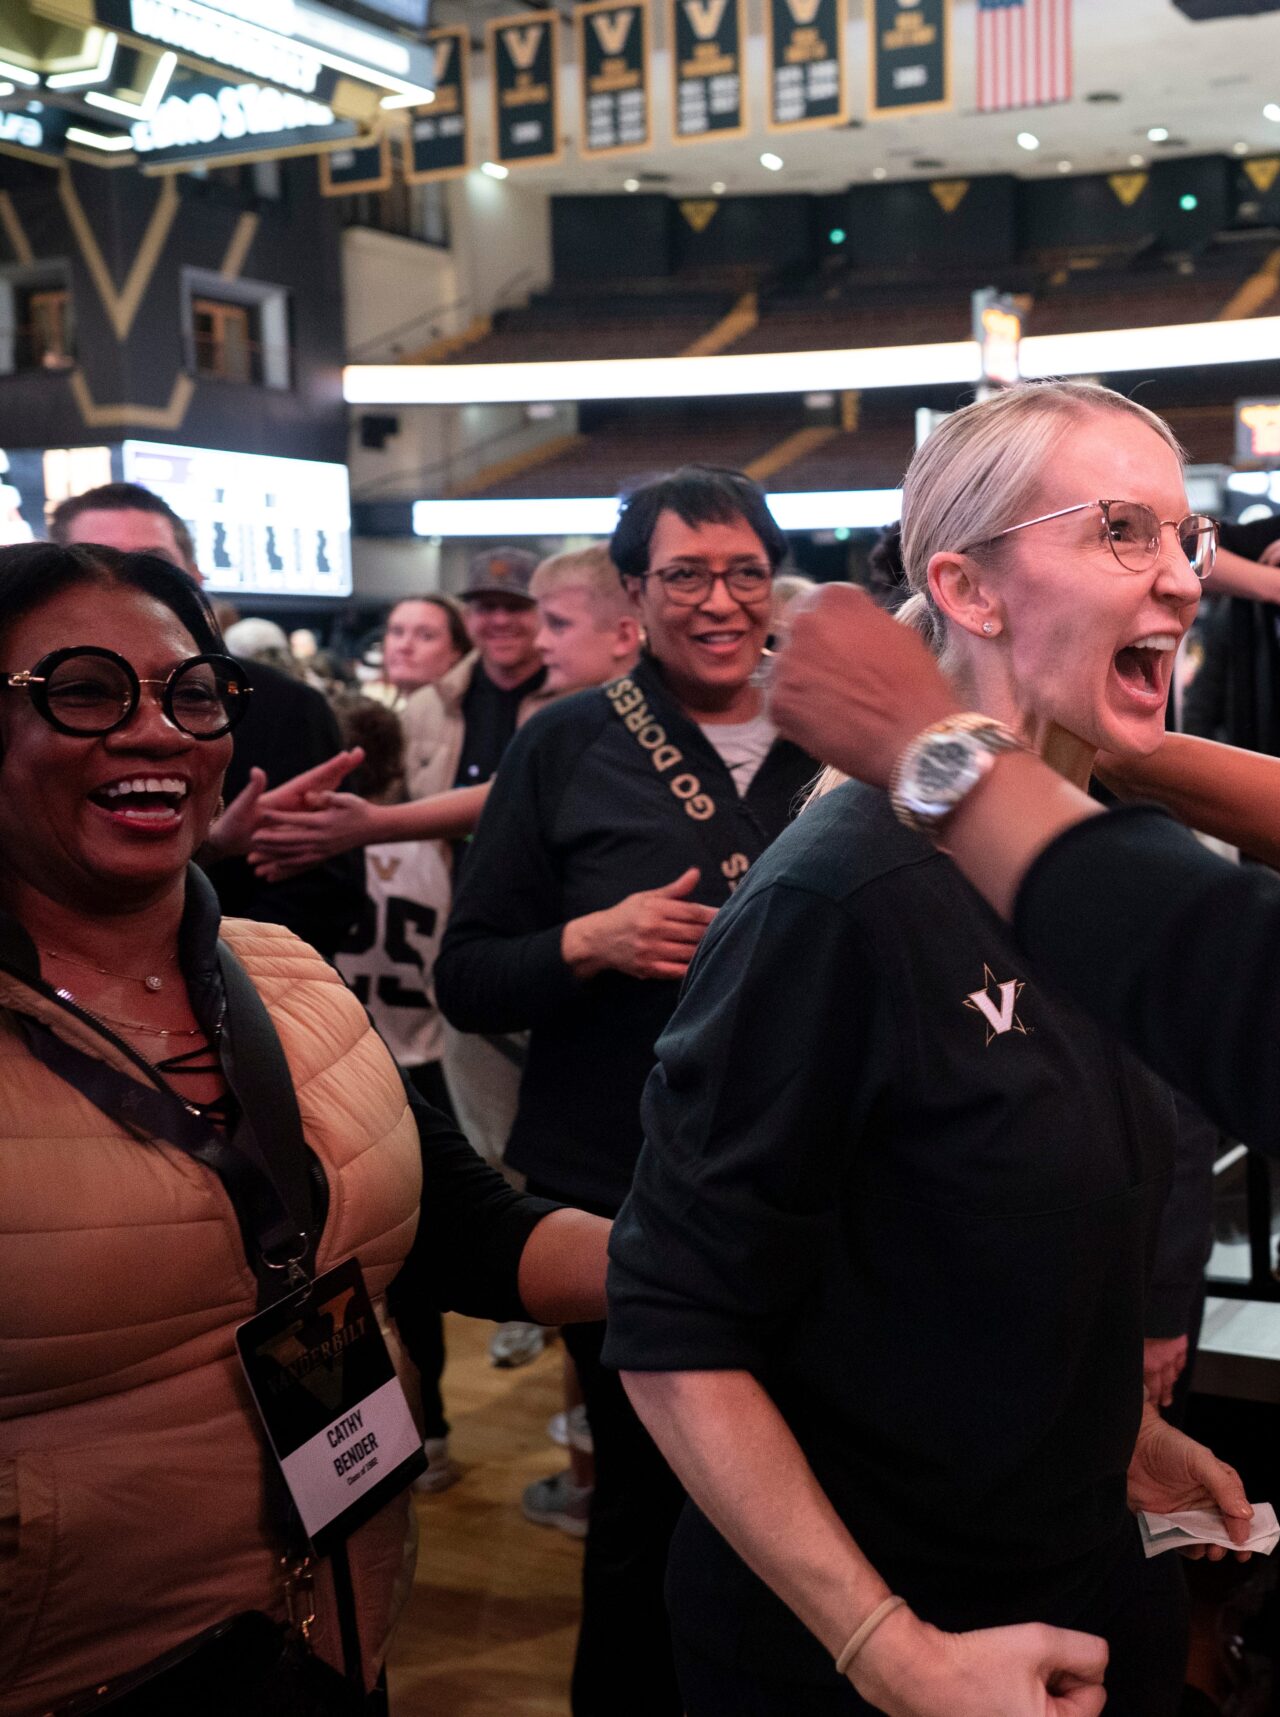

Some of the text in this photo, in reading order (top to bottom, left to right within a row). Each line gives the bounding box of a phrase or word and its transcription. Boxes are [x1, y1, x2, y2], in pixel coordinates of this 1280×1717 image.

[606, 678, 716, 821] GO DORES
[967, 978, 1018, 1035] V
[327, 1408, 364, 1448] CATHY
[333, 1431, 379, 1477] BENDER
